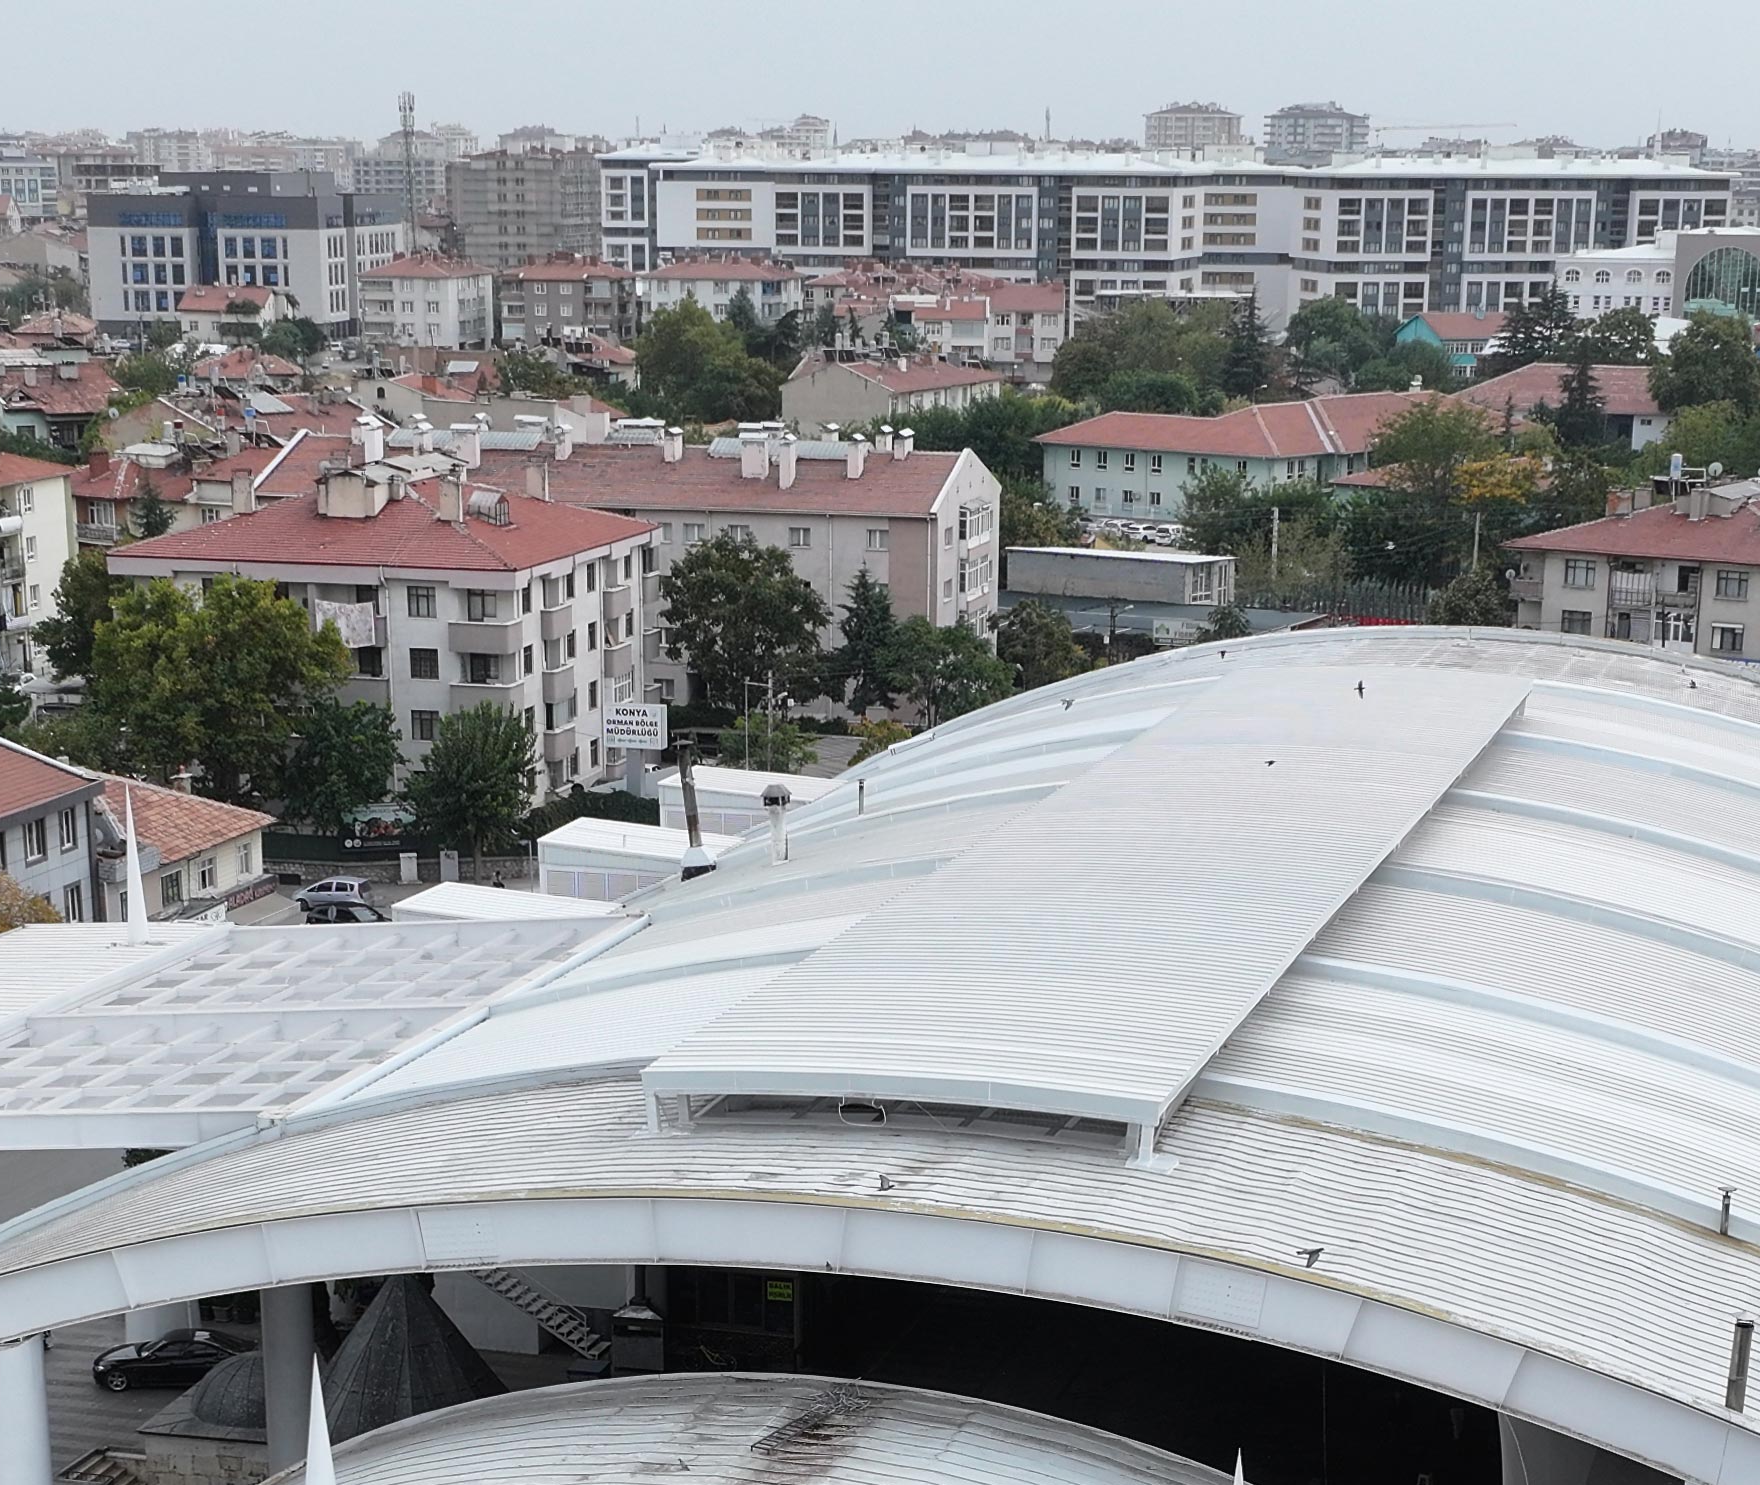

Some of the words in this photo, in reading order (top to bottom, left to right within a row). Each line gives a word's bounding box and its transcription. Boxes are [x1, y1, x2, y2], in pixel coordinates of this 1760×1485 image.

[615, 708, 648, 717] KONYA
[635, 719, 658, 727] BÖLGE
[606, 727, 659, 737] MÜDÜRLÜĞÜ
